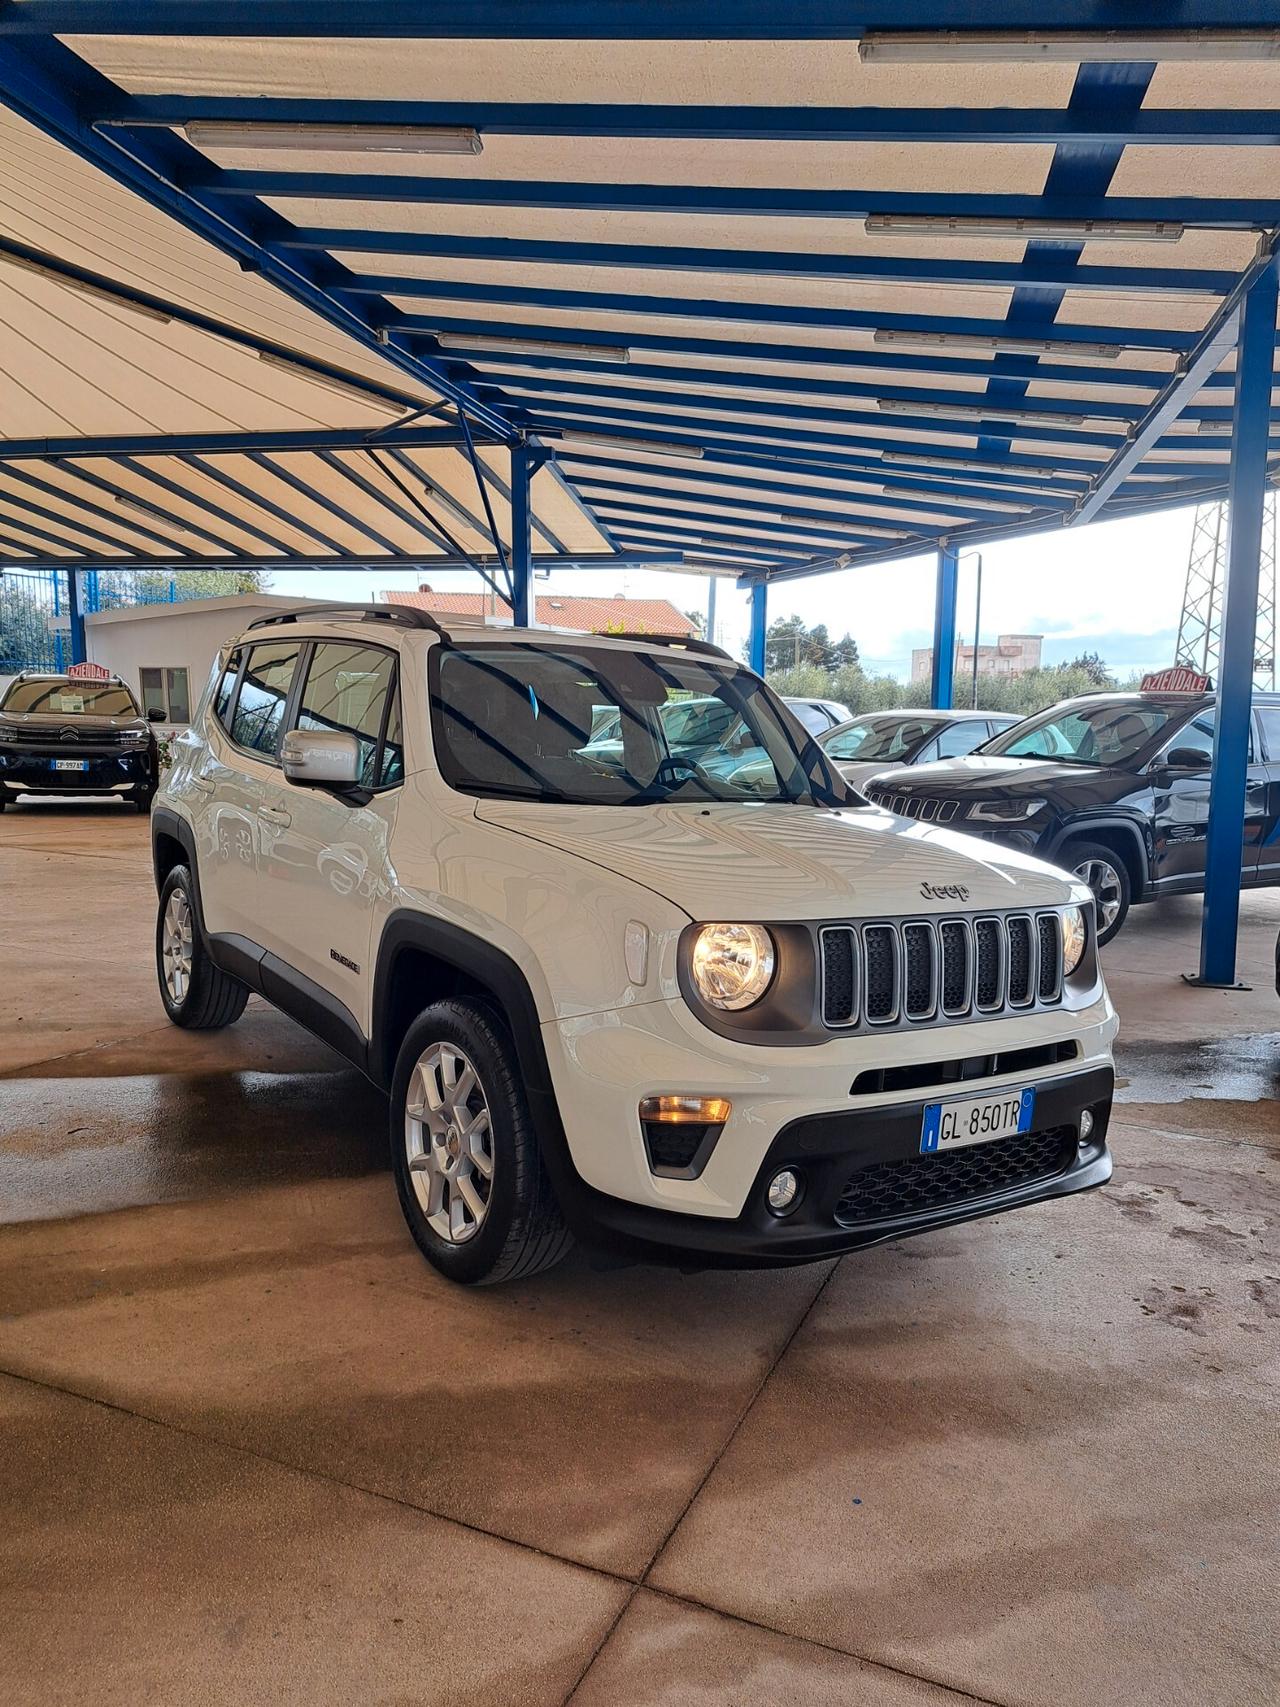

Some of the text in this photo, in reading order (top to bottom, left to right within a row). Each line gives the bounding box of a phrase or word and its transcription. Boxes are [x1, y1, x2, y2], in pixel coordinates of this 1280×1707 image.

[69, 663, 110, 679] AZIENDALE
[1142, 669, 1206, 692] AZIENDALE
[919, 881, 970, 902] Jeep
[941, 1112, 961, 1140] GL
[969, 1100, 1021, 1135] 850TR
